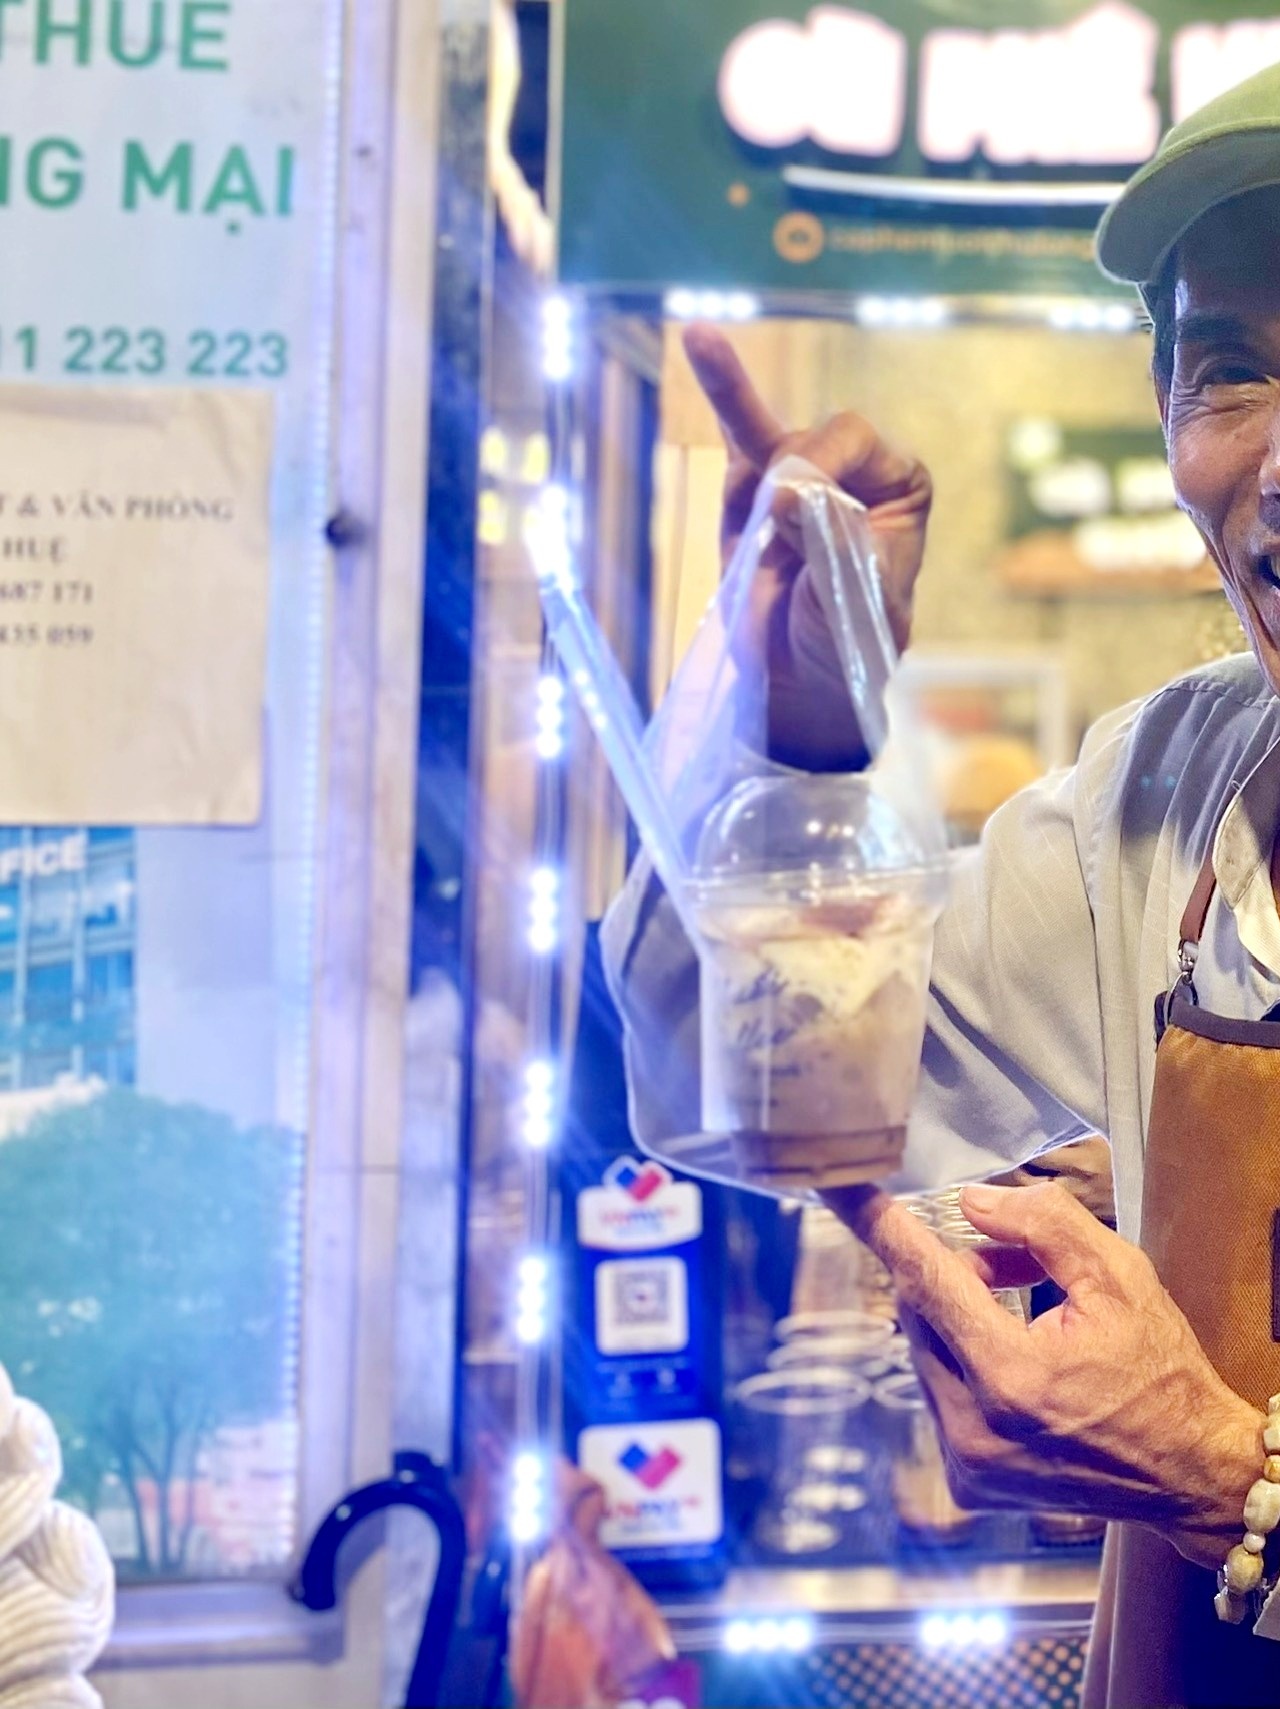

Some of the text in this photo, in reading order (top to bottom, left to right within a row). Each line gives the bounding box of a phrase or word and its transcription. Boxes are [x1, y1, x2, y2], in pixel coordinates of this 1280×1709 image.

[0, 135, 294, 236] G MẠI
[64, 326, 167, 376] 223
[187, 331, 289, 379] 223
